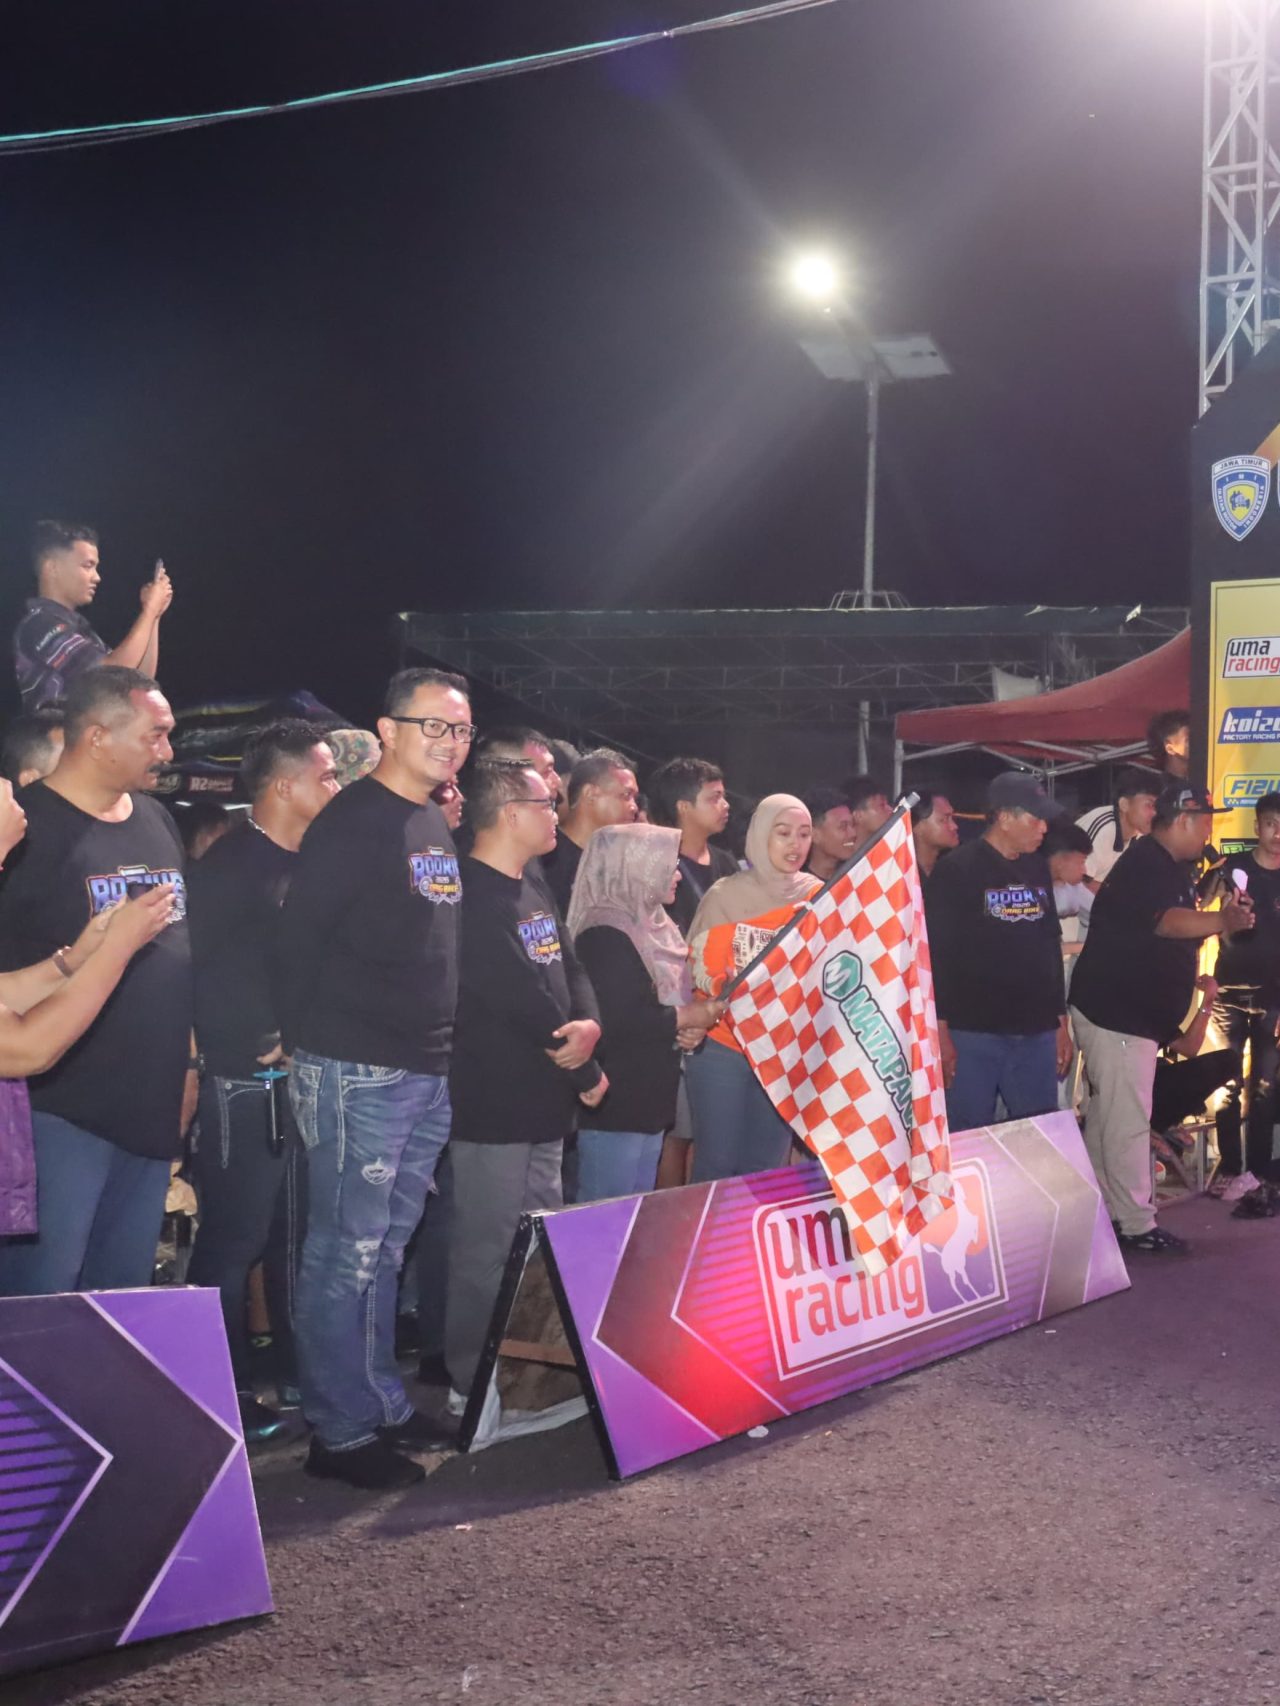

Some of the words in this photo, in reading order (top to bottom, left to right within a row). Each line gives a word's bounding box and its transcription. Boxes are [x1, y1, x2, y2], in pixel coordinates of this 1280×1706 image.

[1219, 459, 1239, 469] JAWA
[1230, 640, 1271, 656] uma
[1223, 733, 1252, 741] FACTORY
[785, 1255, 926, 1344] racing
